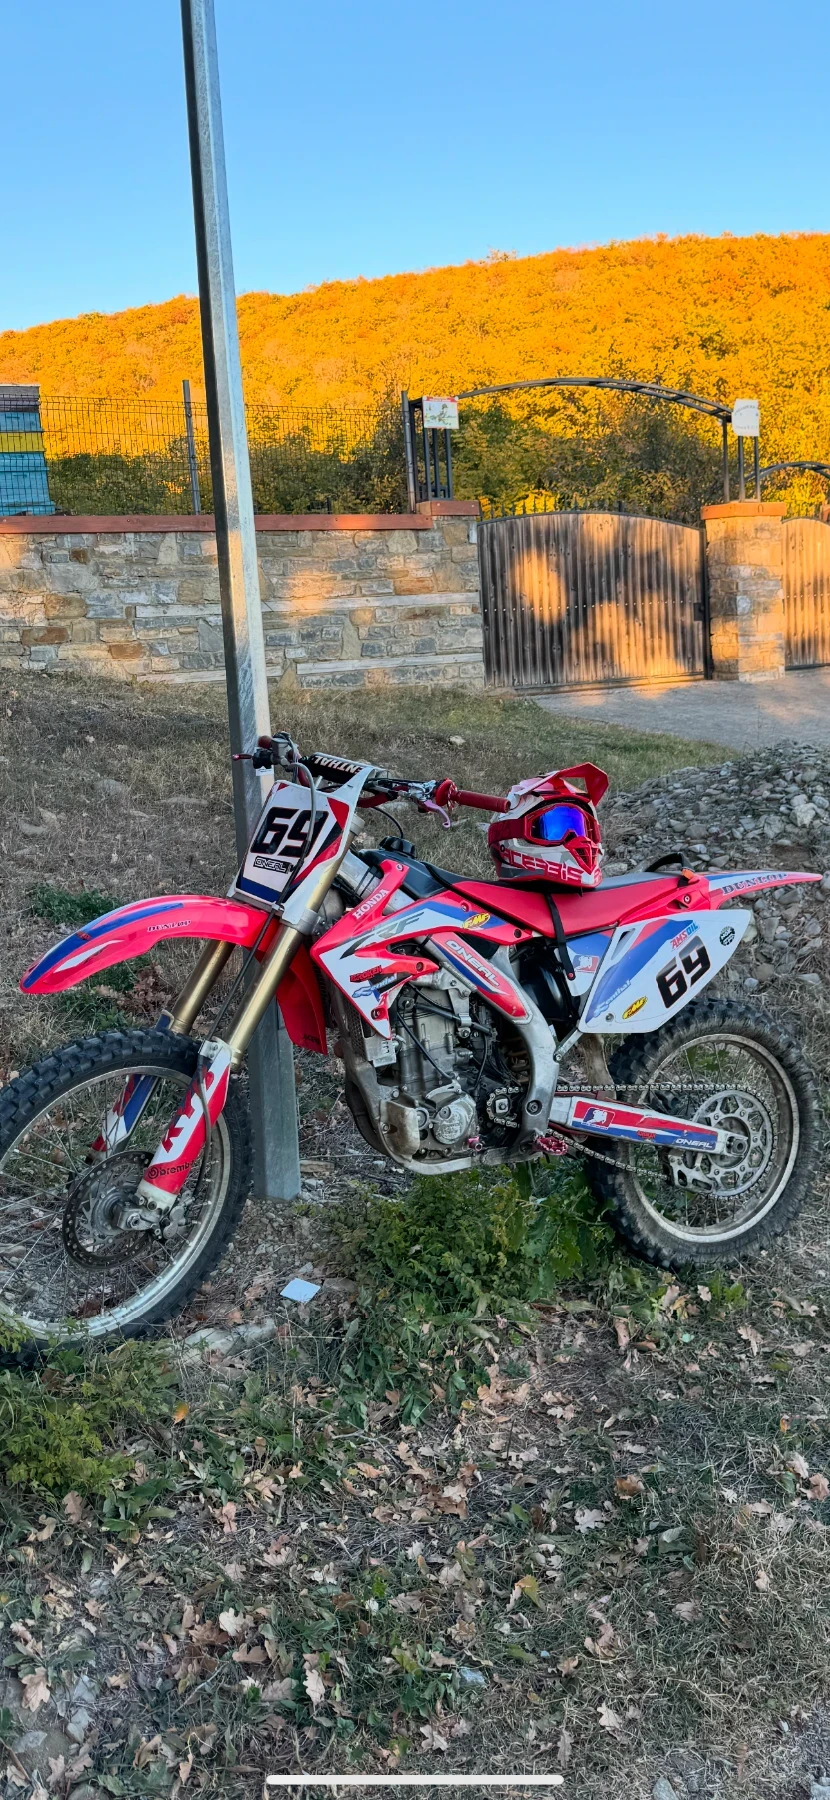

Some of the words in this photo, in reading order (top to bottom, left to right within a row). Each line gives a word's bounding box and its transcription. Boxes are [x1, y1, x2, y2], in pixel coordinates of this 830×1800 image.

[250, 806, 330, 858] 69
[721, 872, 789, 896] DUNLOP
[352, 888, 390, 920] HONDA
[670, 922, 699, 951] AMSOIL
[656, 935, 712, 1009] 69
